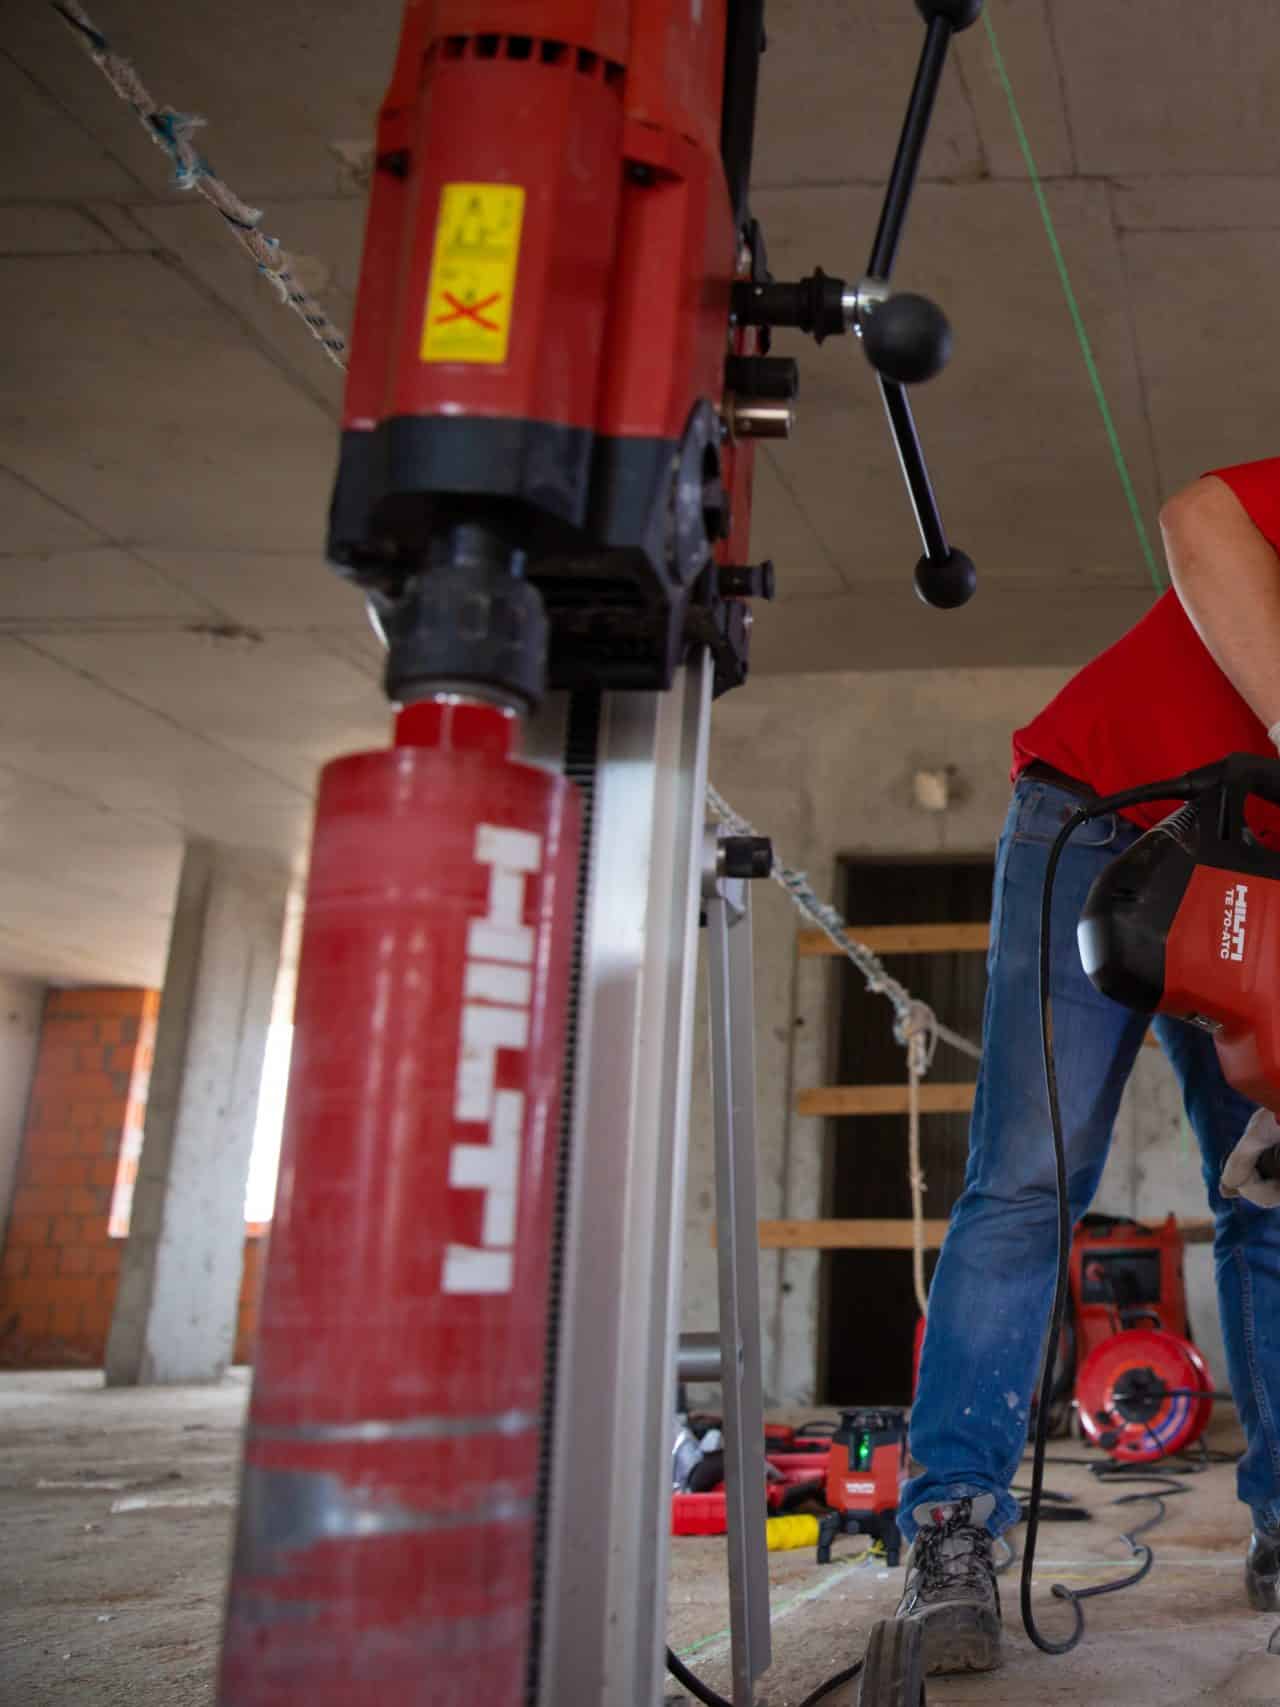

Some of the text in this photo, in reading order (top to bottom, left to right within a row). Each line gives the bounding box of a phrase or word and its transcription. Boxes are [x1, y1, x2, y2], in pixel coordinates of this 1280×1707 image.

[1220, 889, 1234, 960] TE 70-ATC
[1231, 884, 1248, 961] HILTI
[441, 823, 542, 1294] HILTI
